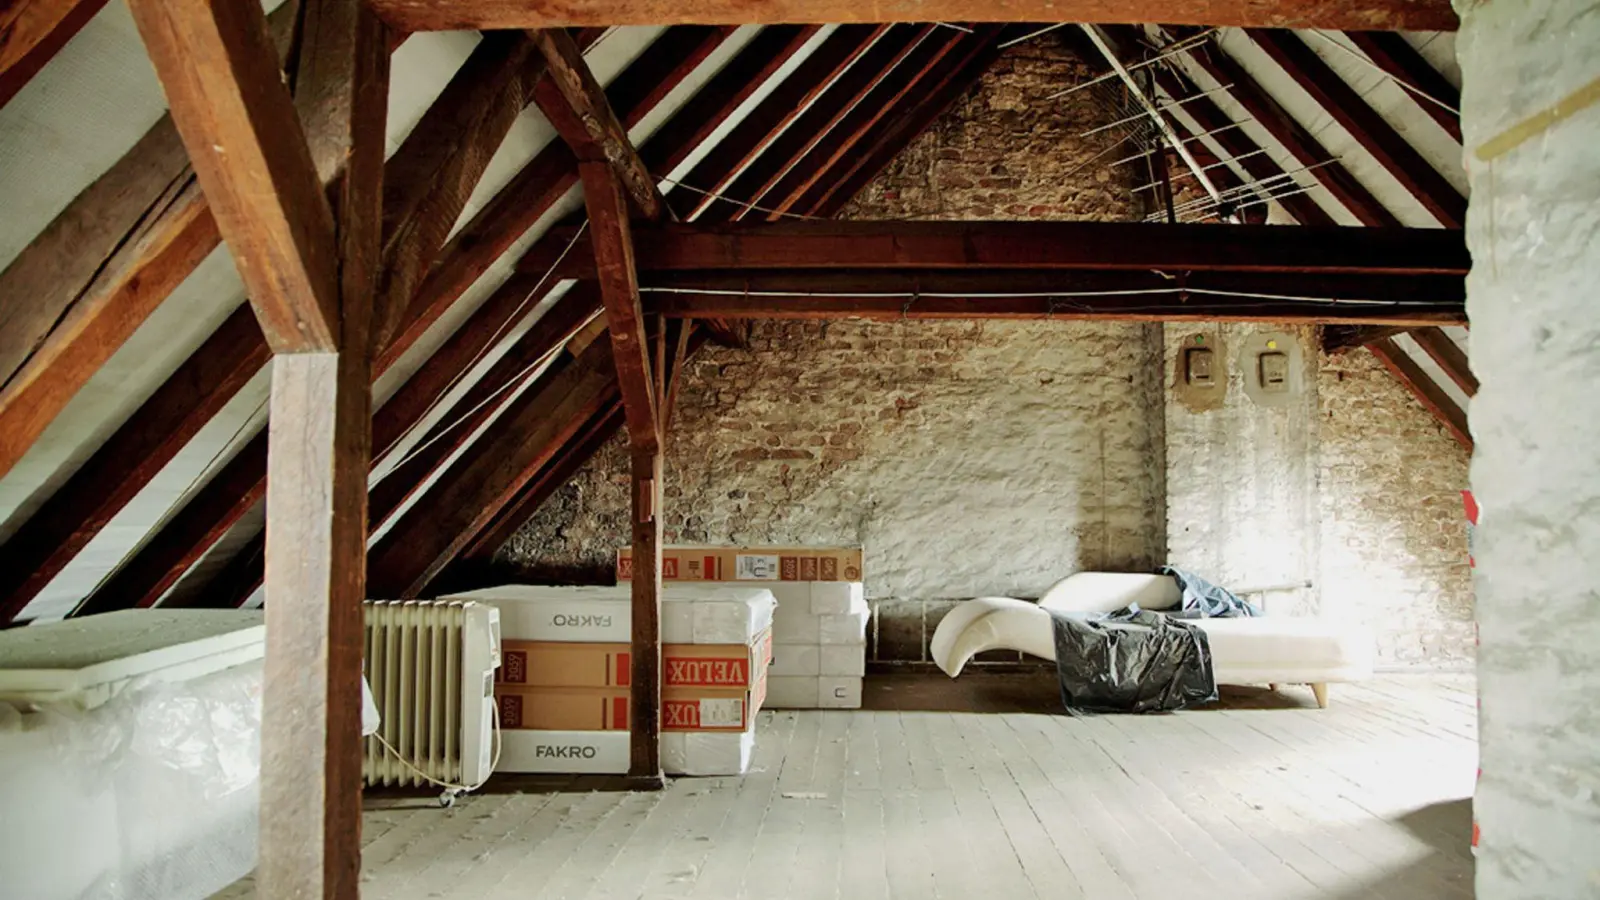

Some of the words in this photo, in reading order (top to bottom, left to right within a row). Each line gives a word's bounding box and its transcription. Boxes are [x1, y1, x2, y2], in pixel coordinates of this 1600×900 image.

[553, 614, 611, 627] FAKRO
[508, 653, 519, 681] 3059
[670, 661, 744, 682] VELUX
[536, 745, 596, 759] FAKRO
